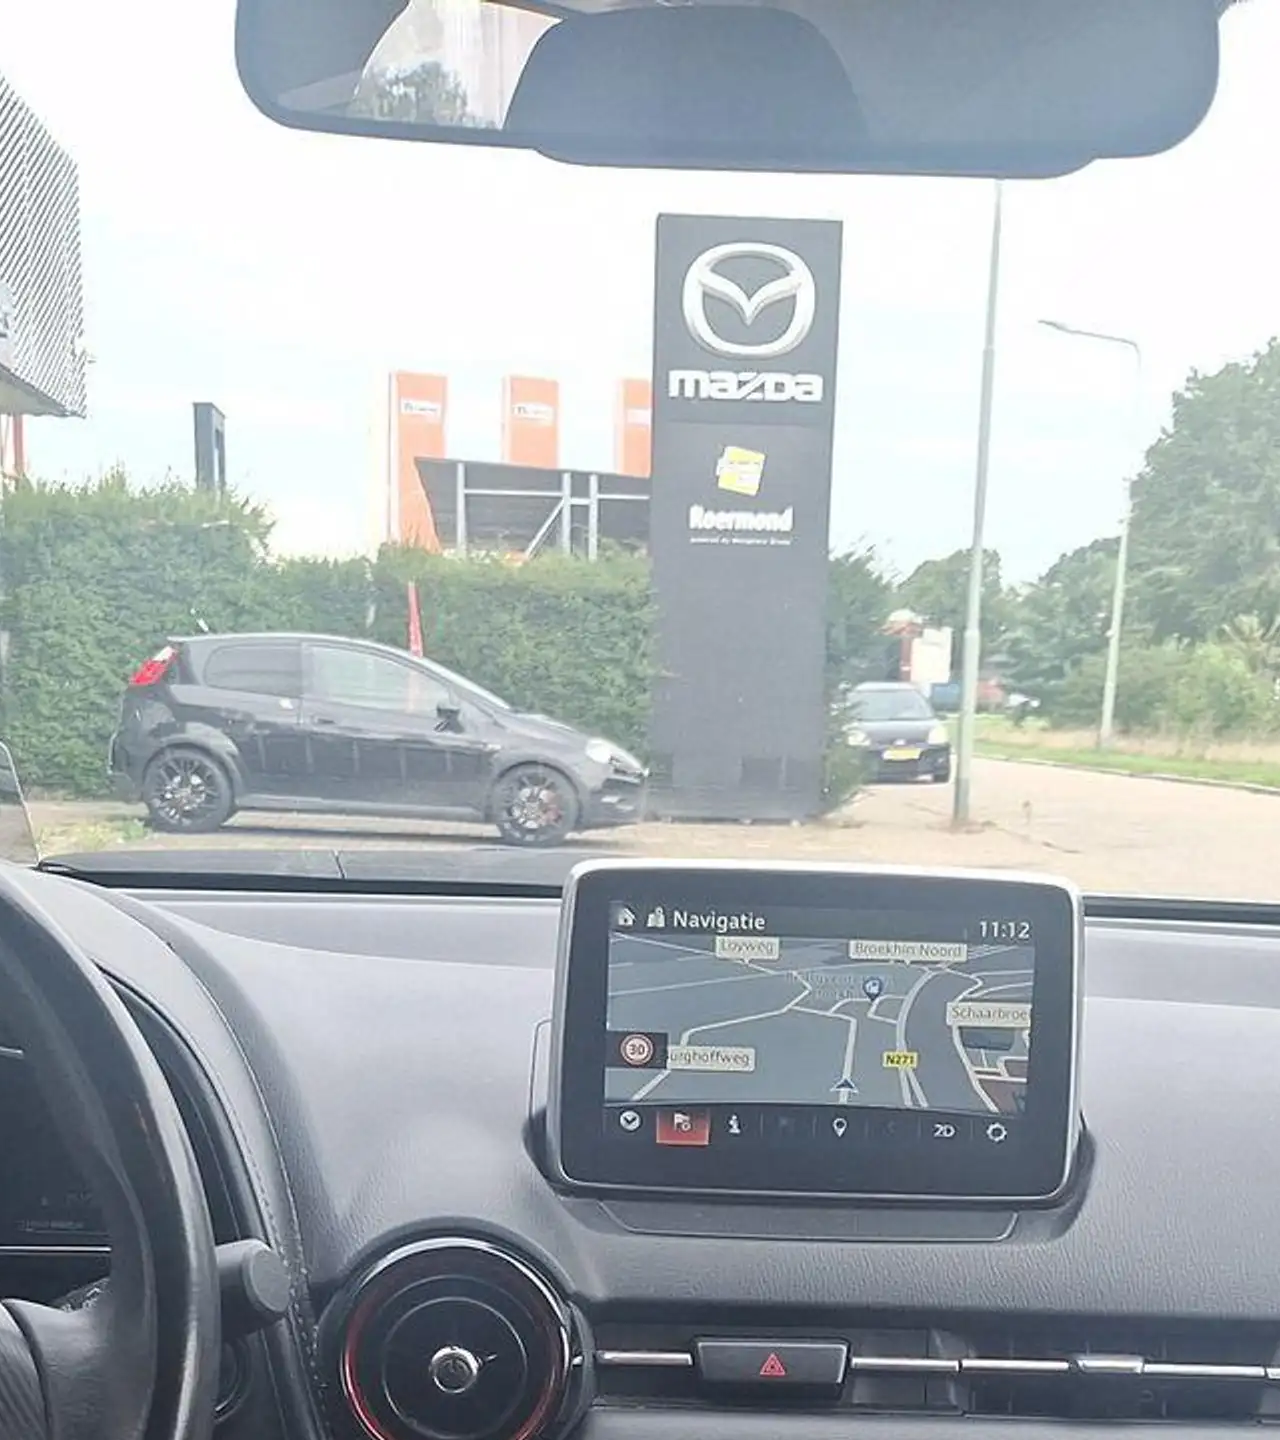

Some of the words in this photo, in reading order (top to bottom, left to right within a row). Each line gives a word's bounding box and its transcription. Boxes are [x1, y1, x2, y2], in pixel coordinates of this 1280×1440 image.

[669, 369, 823, 403] mazda
[689, 504, 794, 532] Roermond
[673, 910, 766, 933] Navigatie
[980, 921, 1031, 939] 11:12
[920, 943, 962, 958] Noord
[629, 1043, 645, 1056] 30
[668, 1050, 750, 1065] urghoffweg
[885, 1054, 914, 1066] N271
[933, 1123, 956, 1138] 2D
